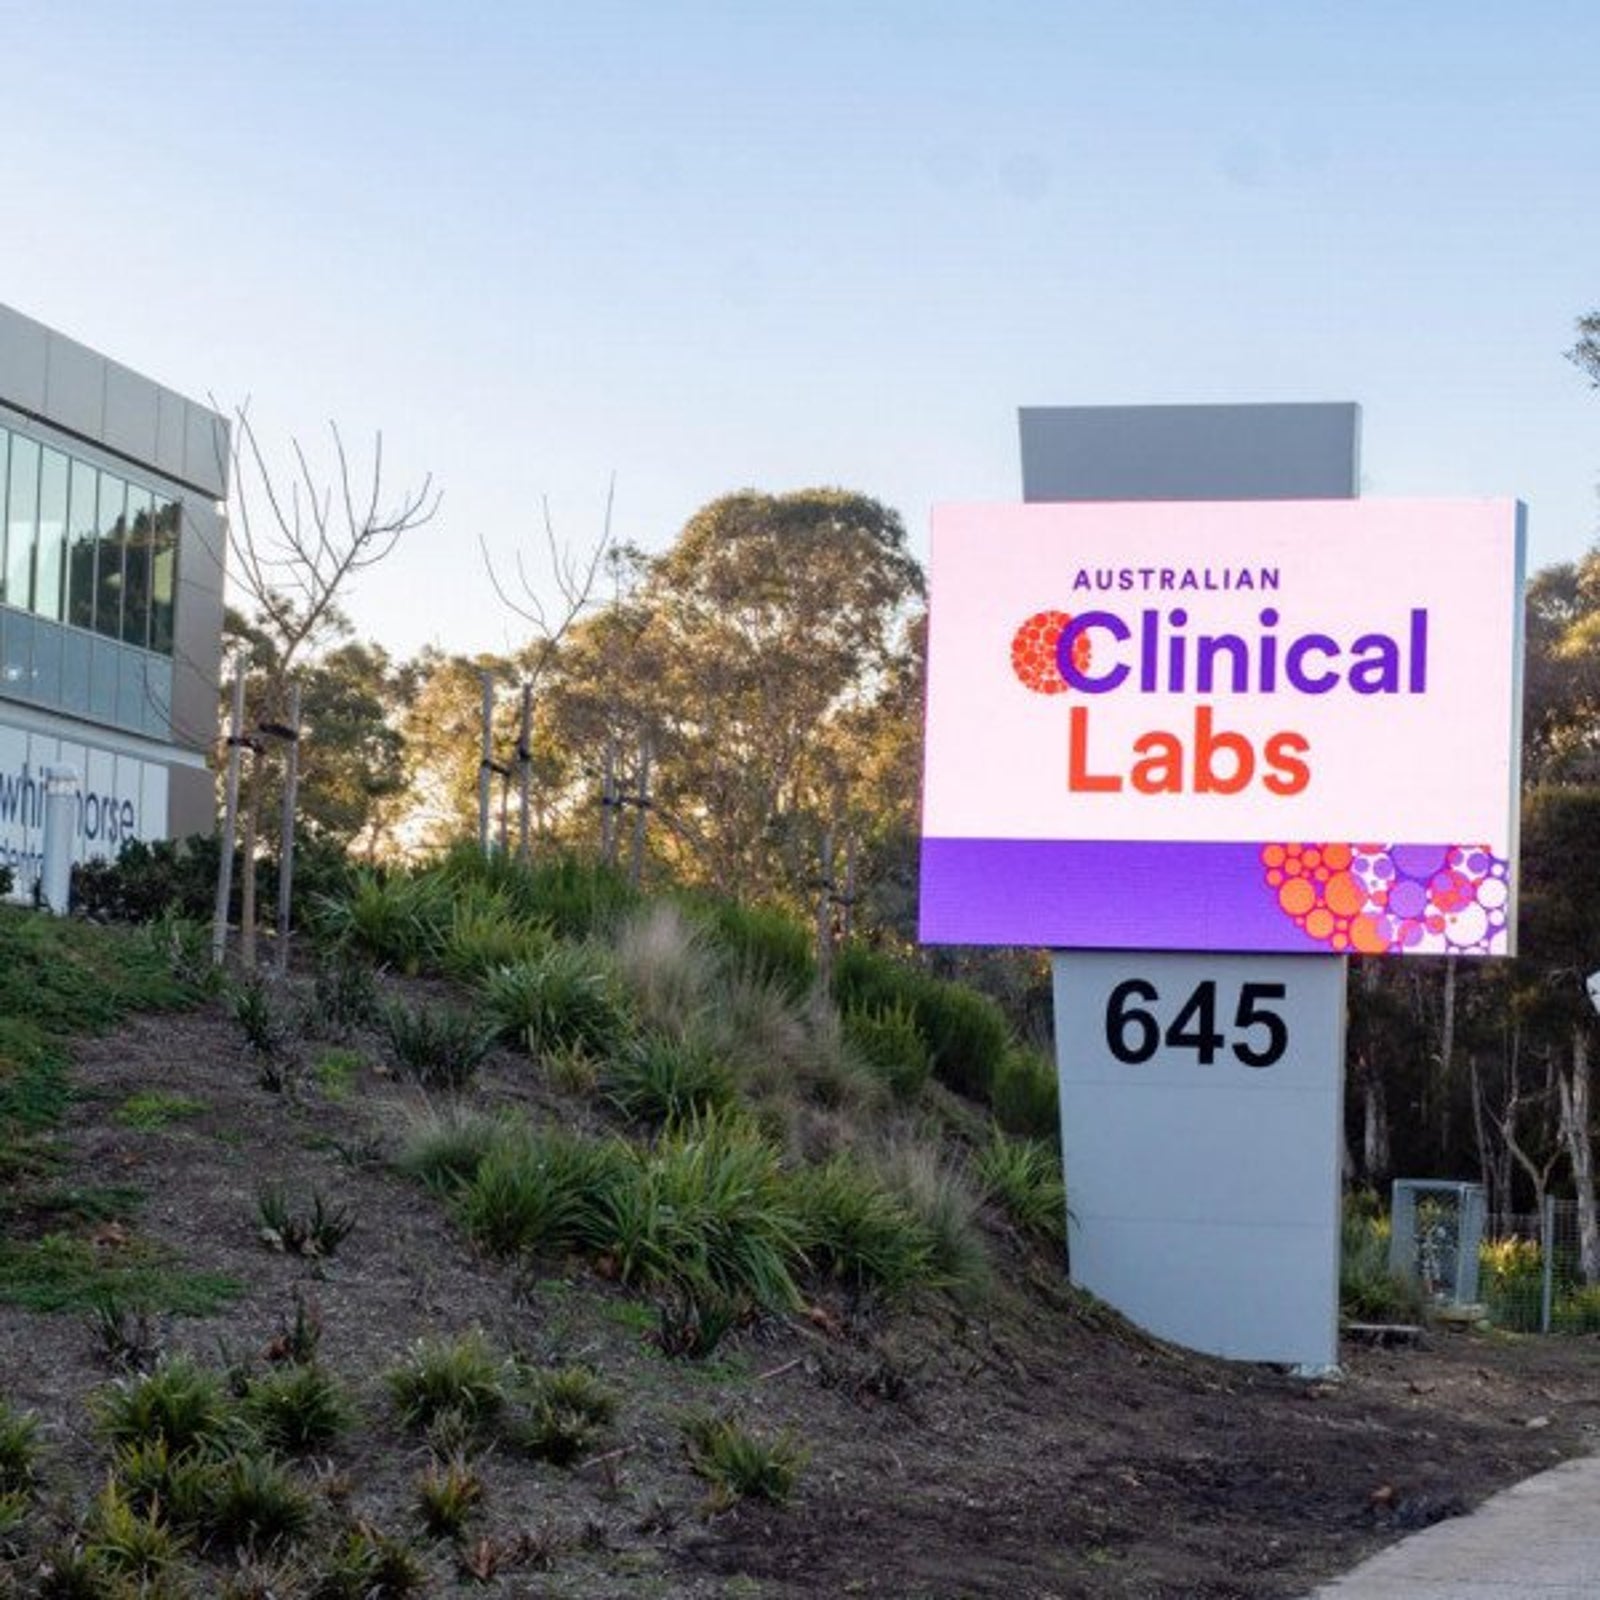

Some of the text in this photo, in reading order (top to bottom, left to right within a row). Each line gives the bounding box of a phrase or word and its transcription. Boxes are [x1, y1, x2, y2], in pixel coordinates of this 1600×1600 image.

[1073, 568, 1279, 591] AUSTRALIAN
[1056, 608, 1427, 695] Clinical
[1068, 705, 1311, 796] Labs
[1105, 978, 1289, 1068] 645
